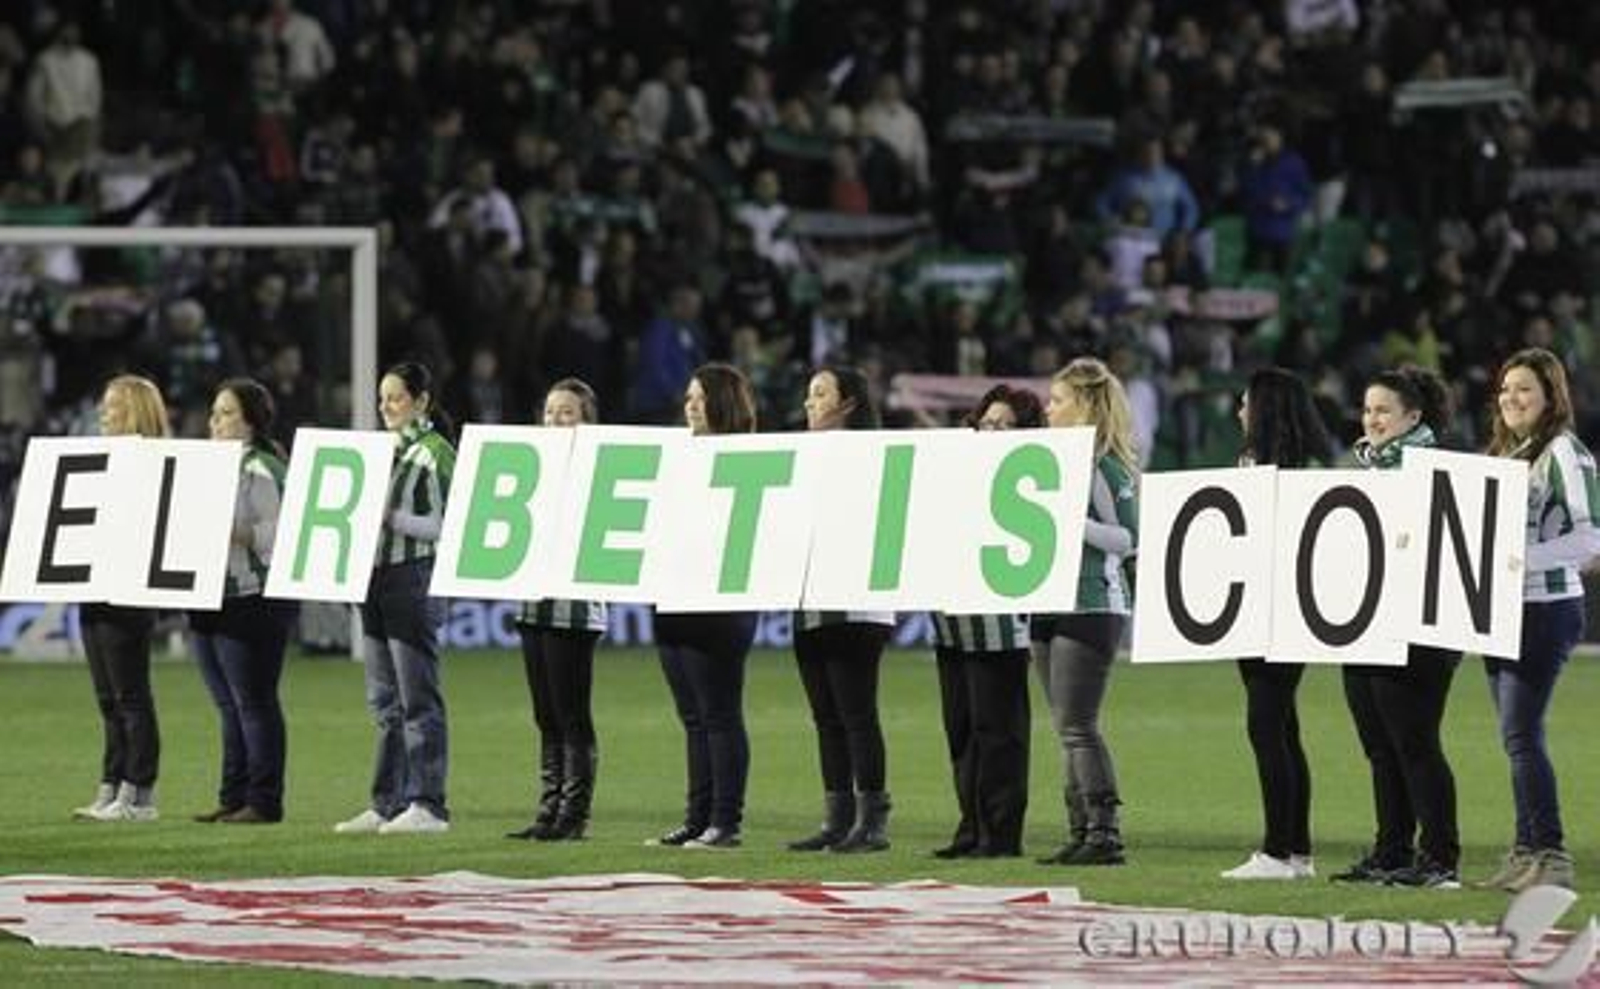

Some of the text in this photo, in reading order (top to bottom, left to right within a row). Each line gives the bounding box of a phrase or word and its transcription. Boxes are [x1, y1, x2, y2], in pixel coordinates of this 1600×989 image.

[36, 442, 1499, 646] EL R BETIS CON
